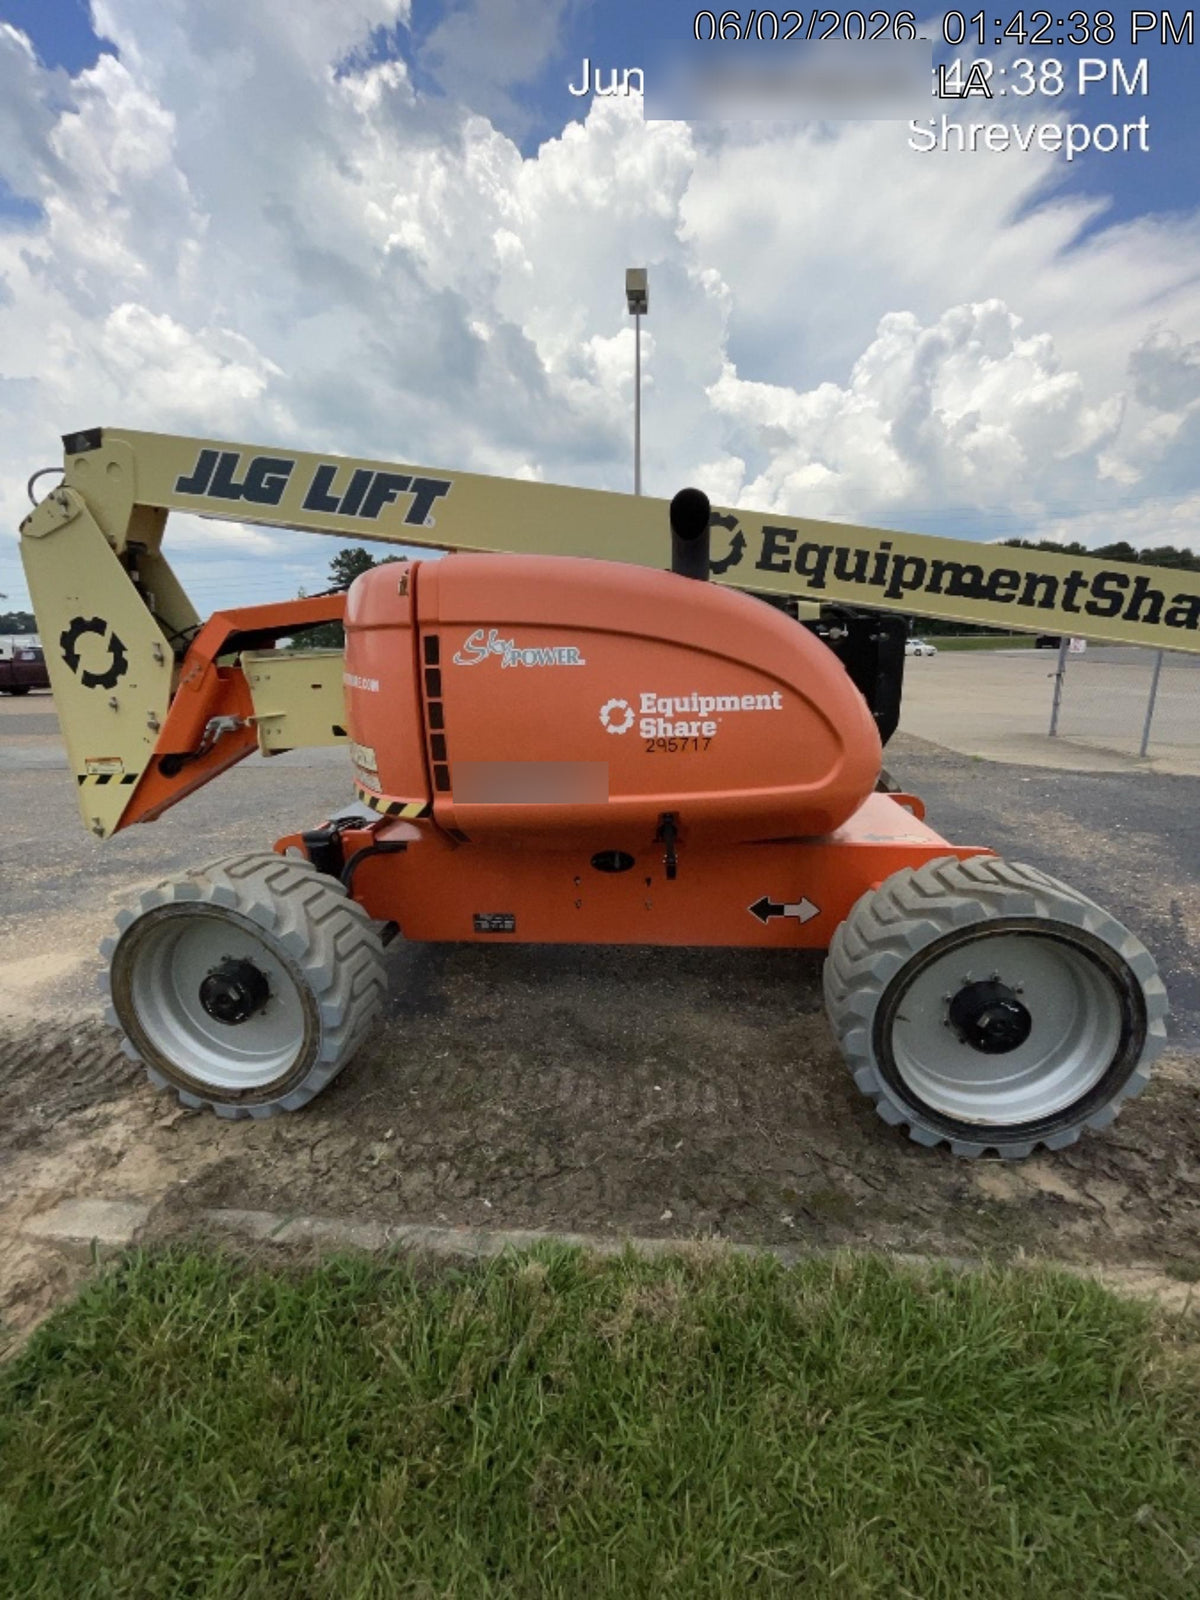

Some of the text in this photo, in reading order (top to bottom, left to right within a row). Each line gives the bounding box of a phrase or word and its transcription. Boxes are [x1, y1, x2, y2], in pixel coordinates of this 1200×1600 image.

[173, 448, 452, 526] JLG LIFT
[639, 690, 784, 718] Equipment
[639, 717, 718, 739] Share
[644, 736, 713, 753] 295717
